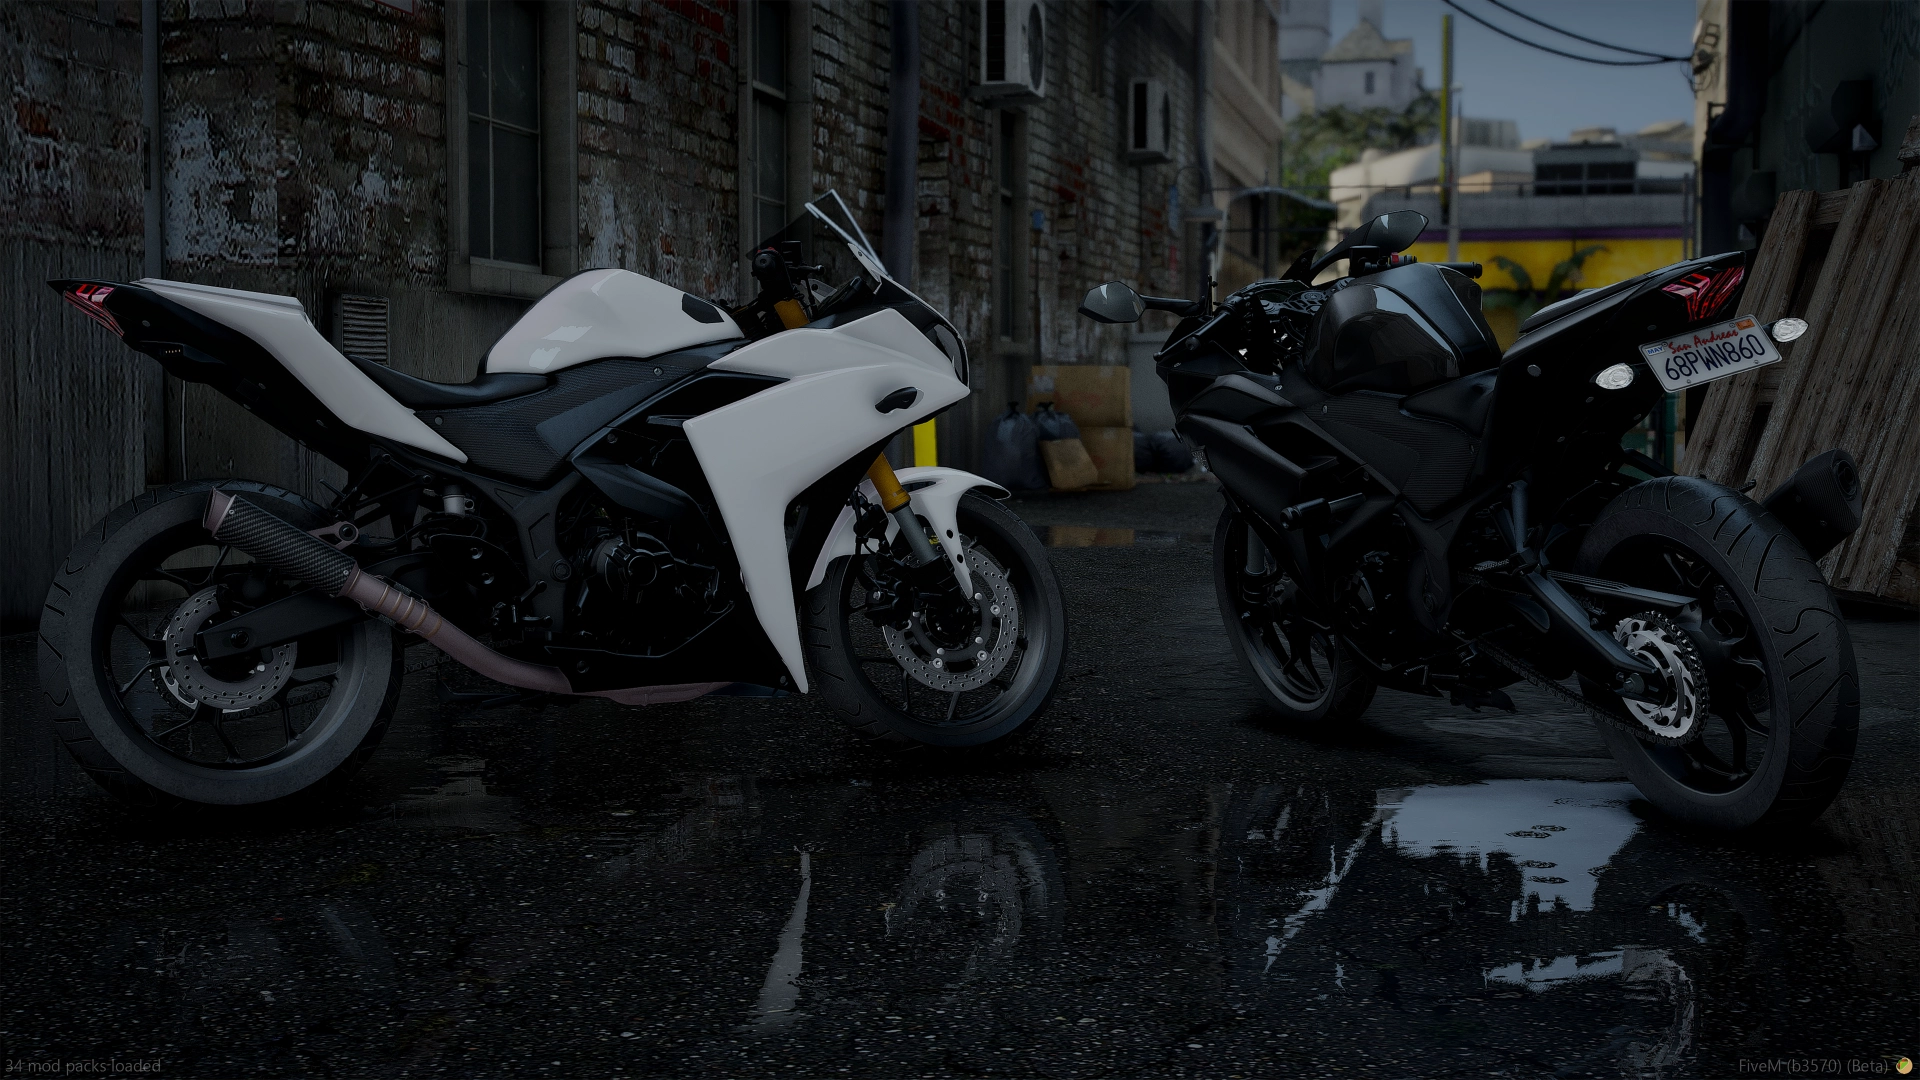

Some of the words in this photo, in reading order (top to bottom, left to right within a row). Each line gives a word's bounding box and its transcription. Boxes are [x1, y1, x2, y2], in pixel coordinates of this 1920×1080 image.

[1665, 334, 1765, 380] 68PWN860
[1668, 341, 1691, 354] San
[1693, 329, 1738, 348] Andreas
